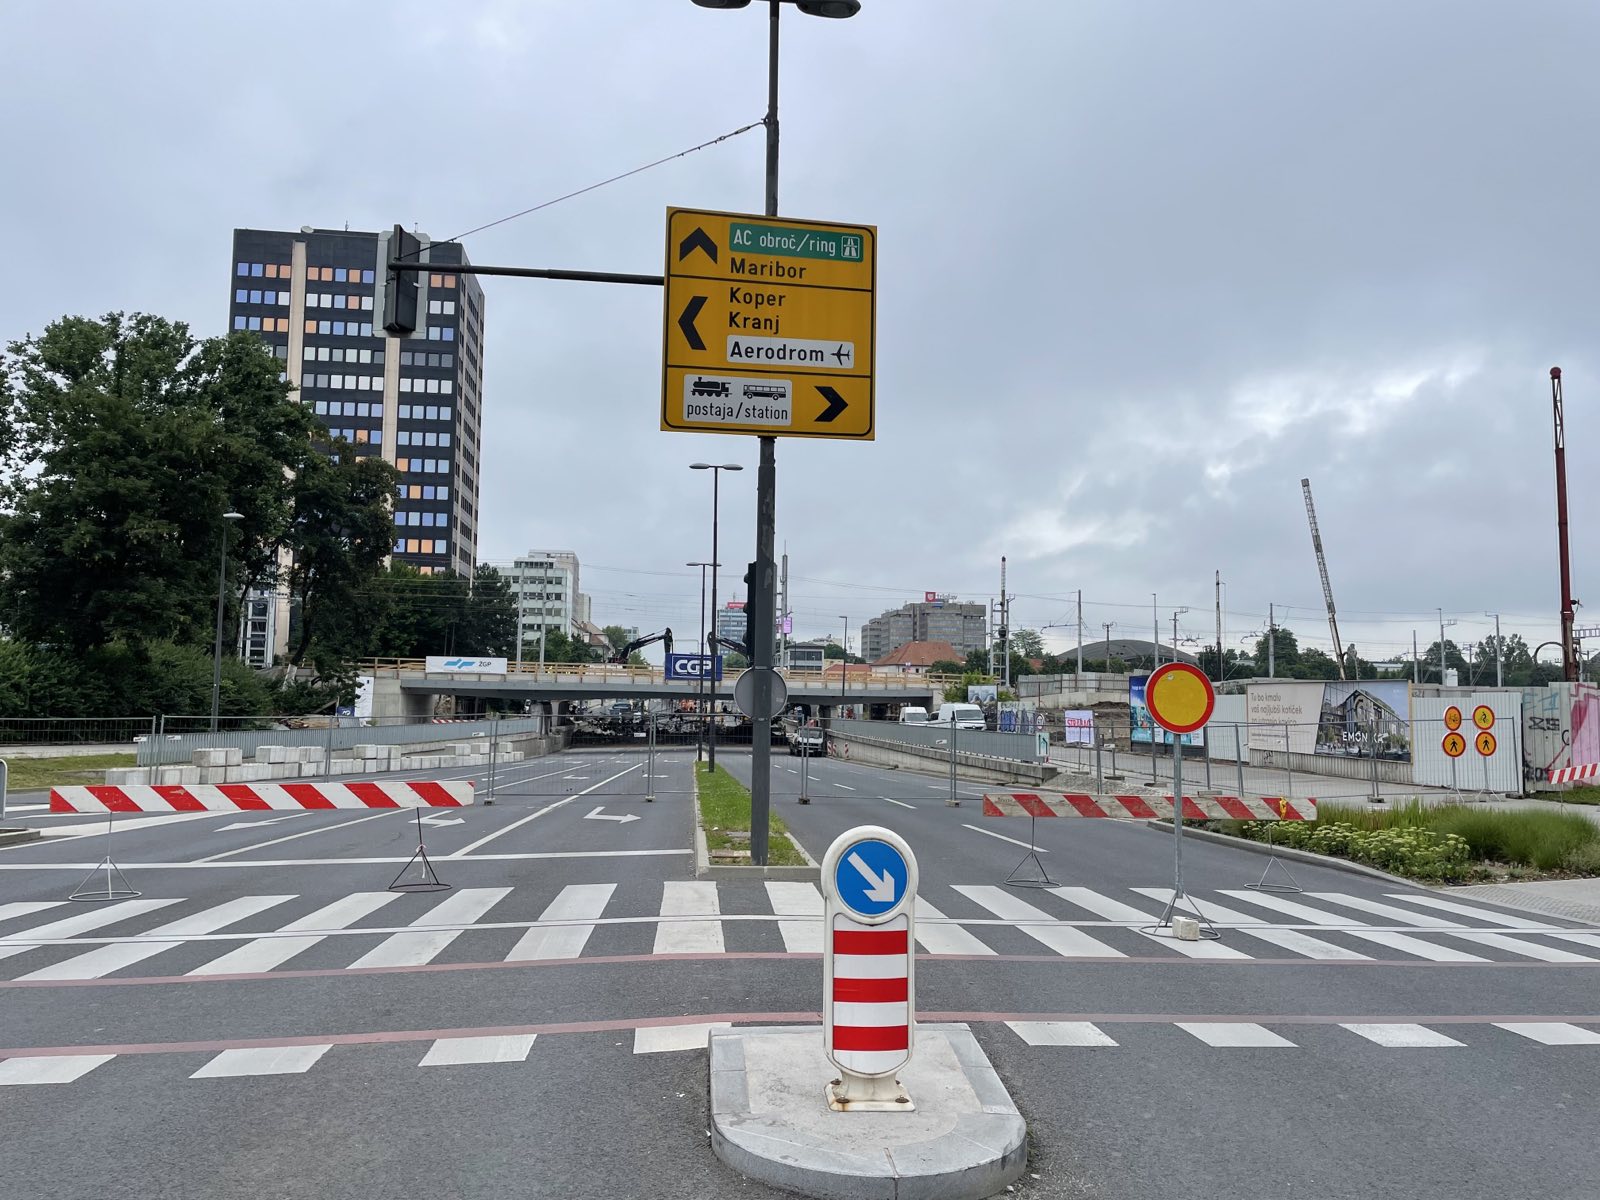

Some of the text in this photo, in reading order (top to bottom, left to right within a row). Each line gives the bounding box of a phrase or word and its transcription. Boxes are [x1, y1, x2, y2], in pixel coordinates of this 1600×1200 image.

[733, 229, 836, 257] AC obroč/ring
[731, 257, 807, 279] Maribor
[730, 287, 786, 309] Koper
[729, 311, 779, 335] Kranj
[730, 341, 824, 362] Aerodrom
[686, 402, 788, 421] postaja/station
[675, 659, 712, 675] CGP
